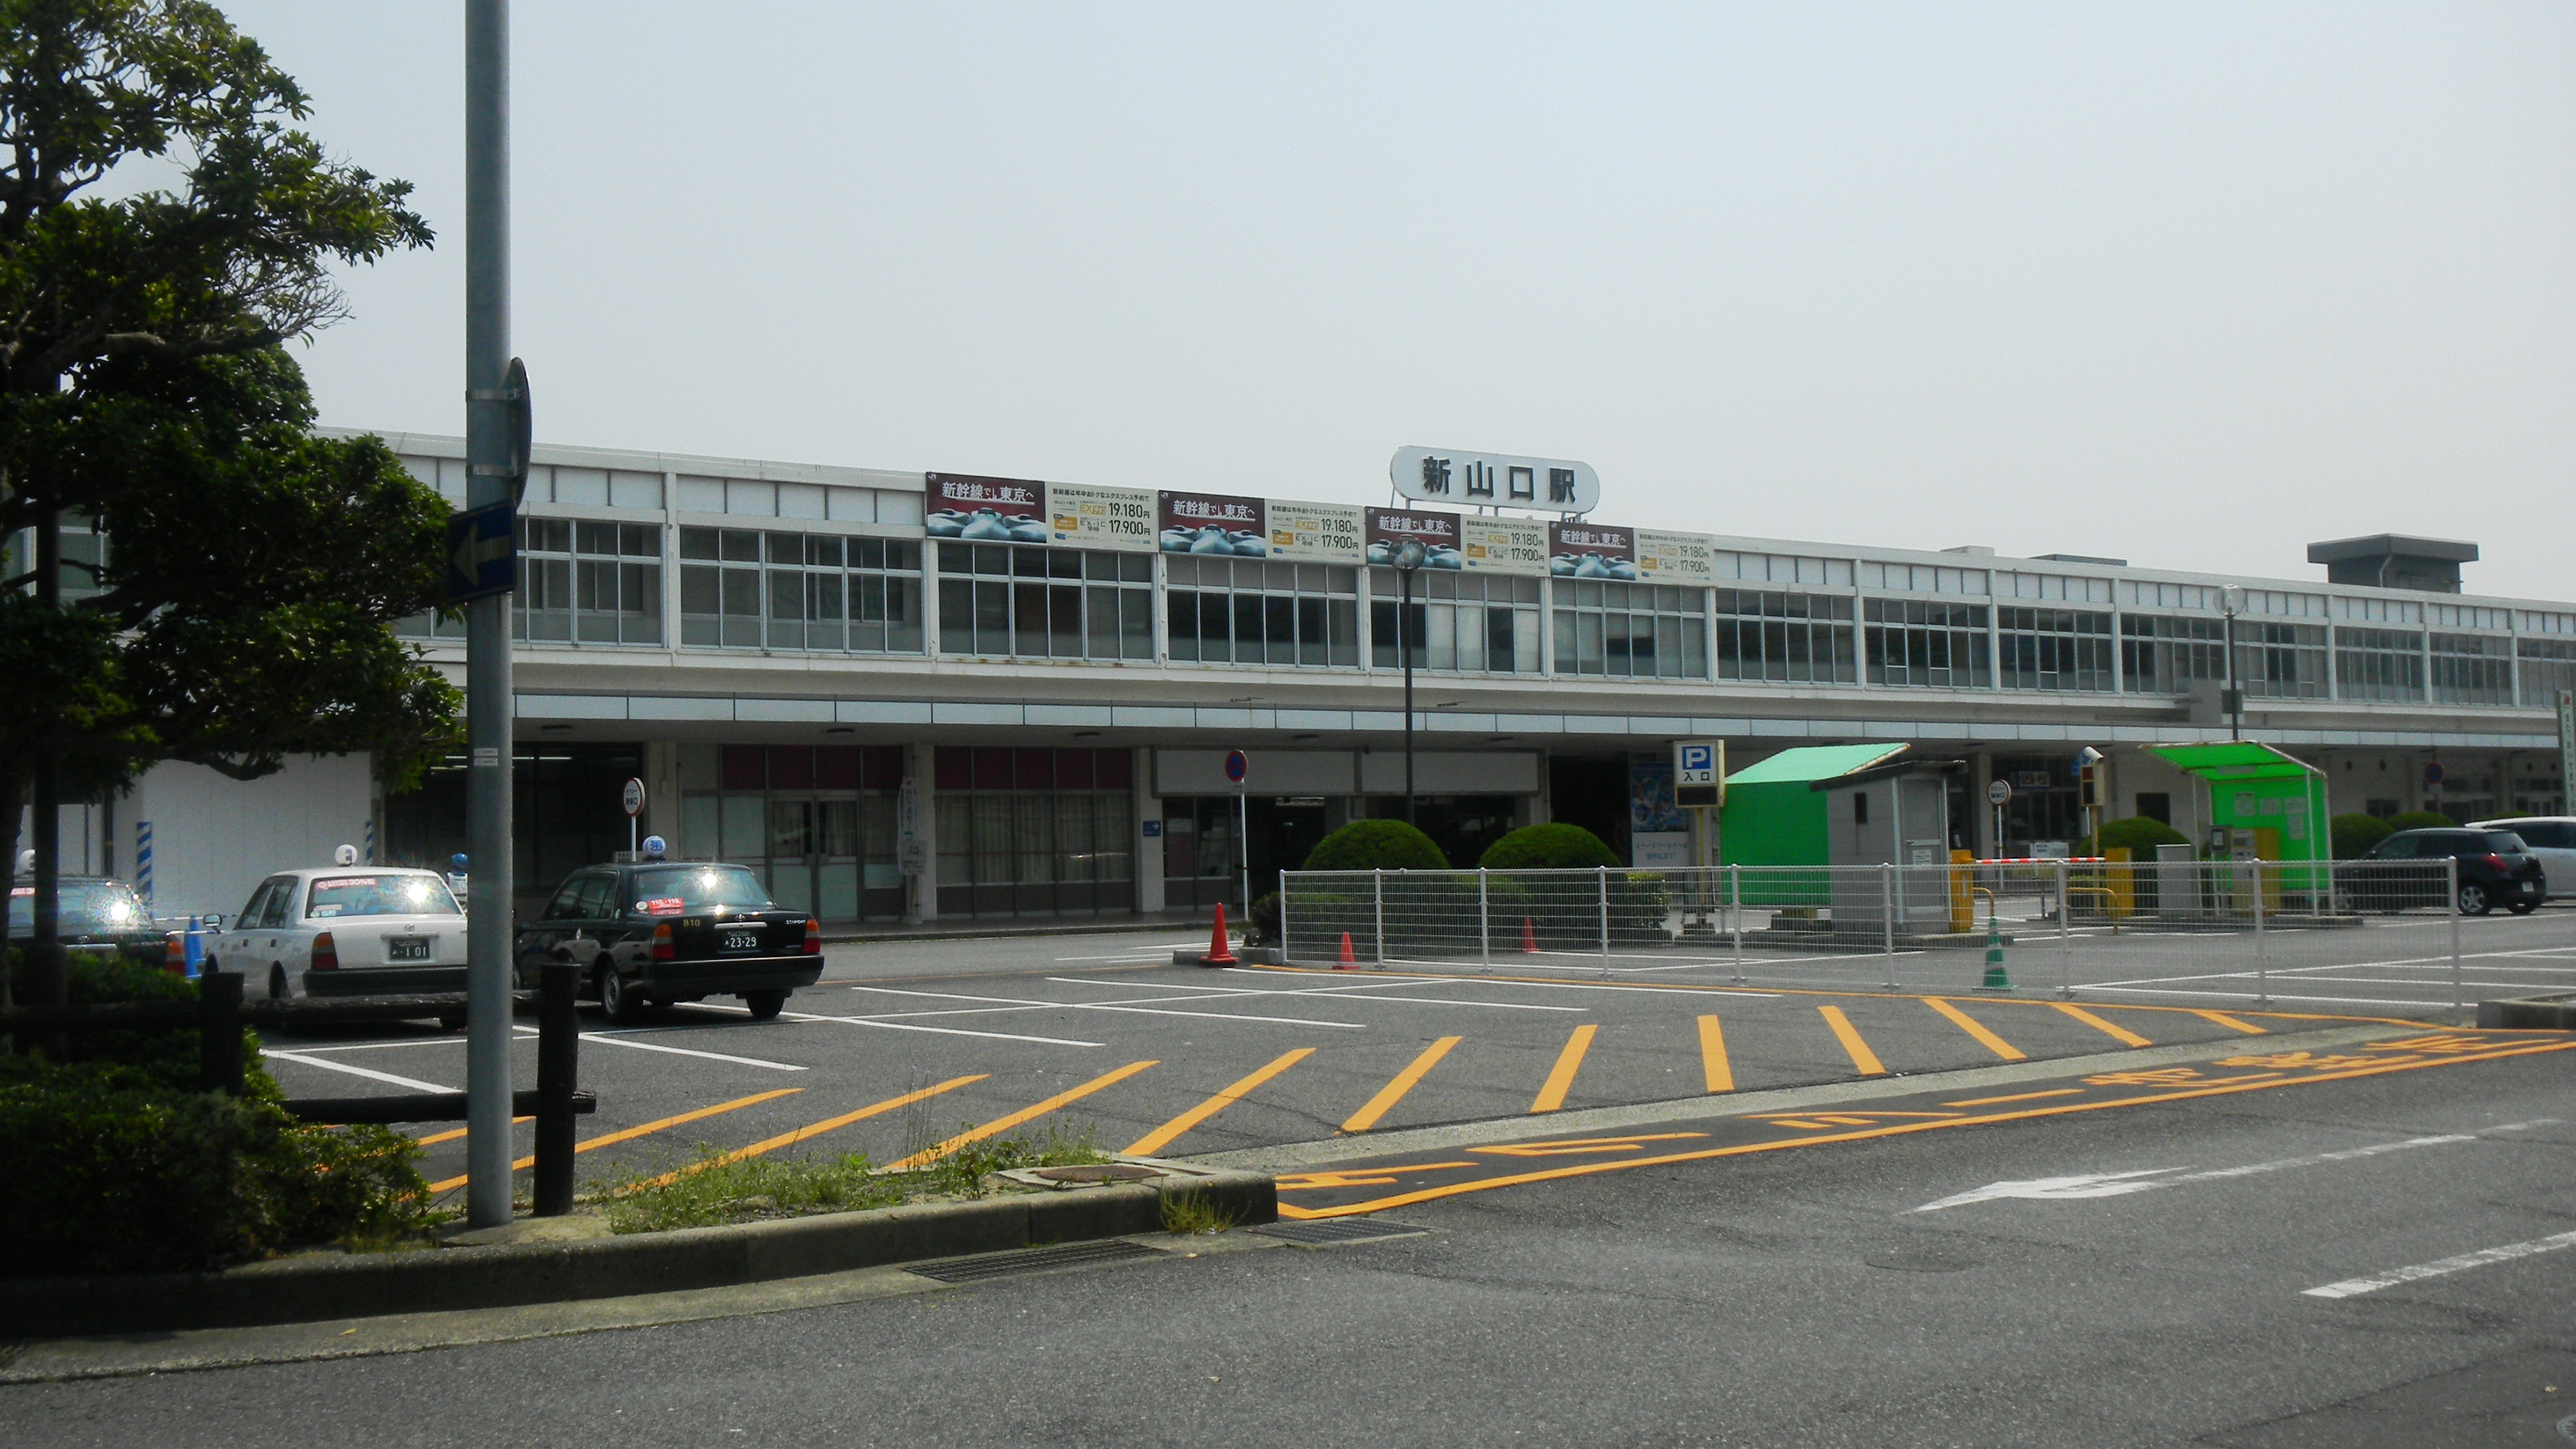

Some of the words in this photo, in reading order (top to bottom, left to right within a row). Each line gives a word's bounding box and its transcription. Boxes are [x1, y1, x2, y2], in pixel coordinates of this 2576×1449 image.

[1422, 456, 1576, 503] 新山口駅
[1685, 748, 1707, 768] P
[1683, 771, 1709, 781] 入口
